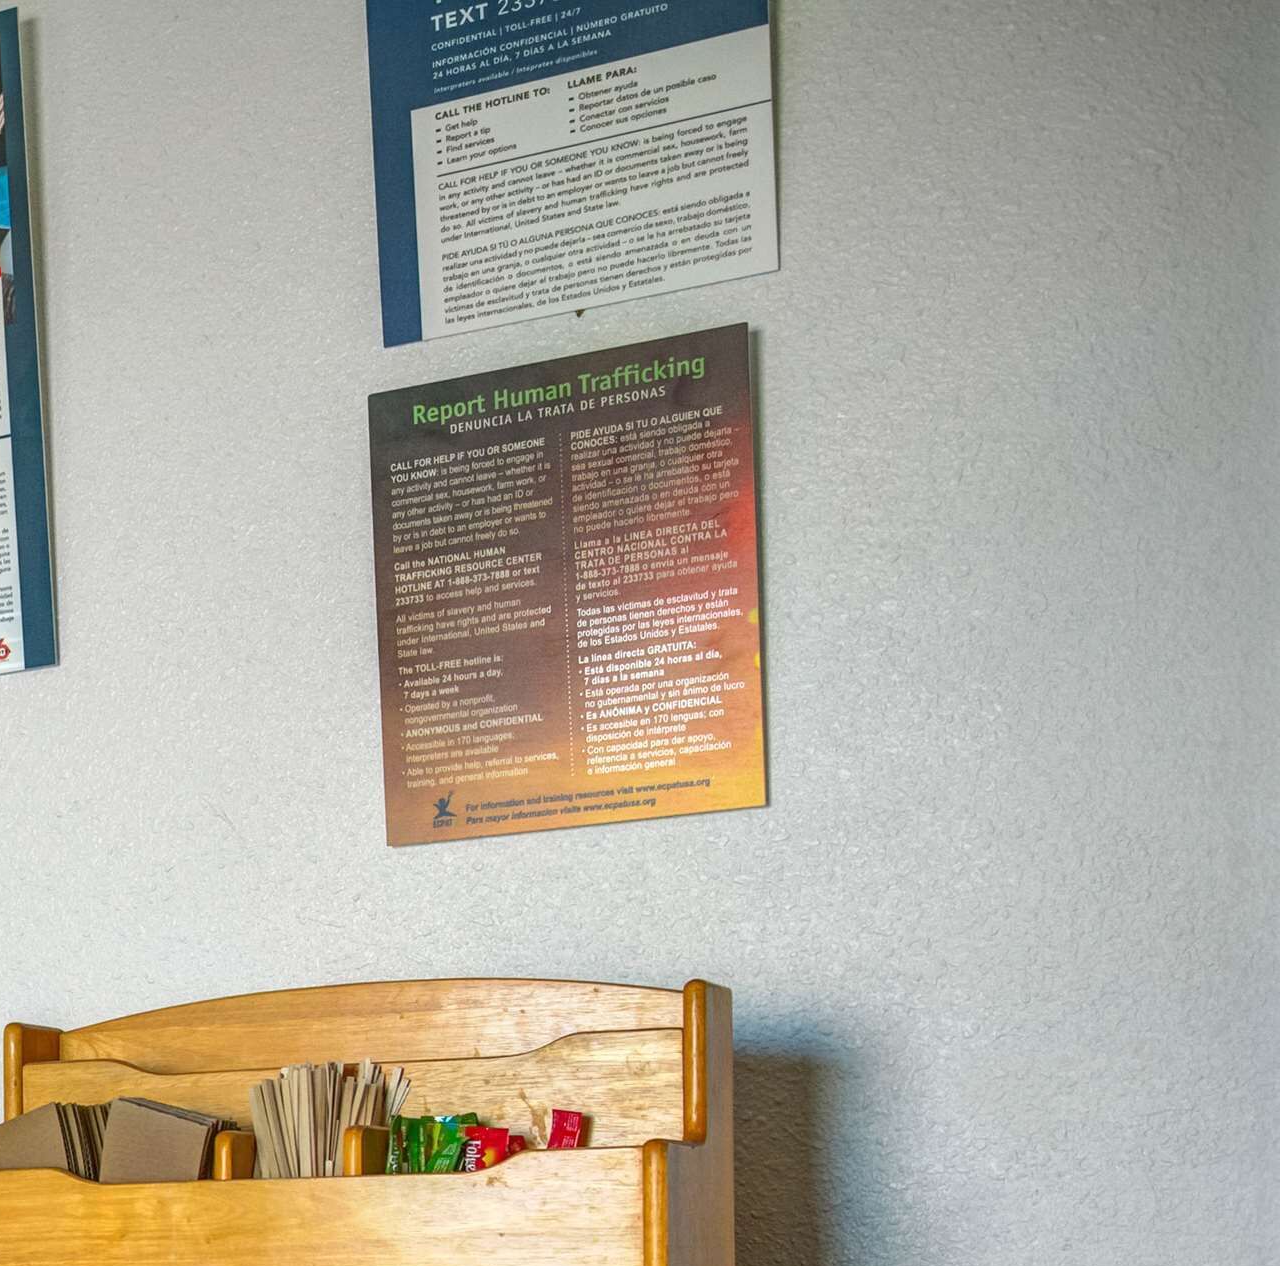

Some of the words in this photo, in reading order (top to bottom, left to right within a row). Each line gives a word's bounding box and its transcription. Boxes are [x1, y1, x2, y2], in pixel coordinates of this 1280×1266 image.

[430, 2, 488, 31] TEXT
[431, 29, 496, 51] CONFIDENTIAL
[505, 14, 552, 32] TOLL-FREE
[561, 7, 580, 19] 24/7
[499, 29, 568, 51] CONFIDENCIAL
[620, 3, 668, 21] GRATUITO
[433, 71, 443, 79] 24
[446, 62, 476, 76] HORAS
[479, 59, 490, 68] AL
[493, 55, 512, 64] DÍA,
[515, 51, 520, 59] 7
[523, 45, 544, 57] DÍAS
[547, 43, 554, 51] A
[557, 40, 568, 48] LA
[571, 29, 611, 45] SEMANA
[567, 74, 602, 89] LLAME
[605, 66, 637, 80] PARA:
[578, 88, 612, 100] Obtener
[614, 80, 638, 92] ayuda
[578, 98, 614, 111] Reportar
[615, 92, 638, 103] datos
[640, 88, 651, 97] de
[665, 78, 695, 92] posible
[697, 74, 717, 83] caso
[435, 108, 460, 120] CALL
[462, 102, 482, 113] THE
[485, 91, 529, 108] HOTLINE
[533, 87, 550, 97] TO:
[445, 123, 459, 131] Get
[461, 119, 478, 128] help
[445, 131, 471, 142] Report
[480, 127, 491, 135] tip
[413, 395, 486, 425] Report
[494, 382, 571, 410] Human
[577, 357, 704, 394] Trafficking
[450, 414, 512, 434] DENUNCIA
[518, 410, 532, 422] LA
[537, 403, 574, 418] TRATA
[580, 398, 595, 411] DE
[600, 386, 665, 407] PERSONAS
[570, 429, 591, 440] PIDE
[592, 424, 623, 436] AYUDA
[625, 421, 634, 431] SI
[635, 419, 648, 428] TU
[650, 417, 658, 426] O
[659, 410, 700, 424] ALGUIEN
[702, 405, 722, 416] QUE
[390, 461, 412, 472] CALL
[414, 457, 432, 468] FOR
[433, 453, 455, 464] HELP
[457, 451, 464, 460] IF
[466, 448, 485, 458] YOU
[487, 445, 500, 455] OR
[501, 437, 545, 452] SOMEONE
[570, 435, 617, 450] CONOCES:
[391, 473, 408, 483] YOU
[578, 656, 589, 664] La
[614, 648, 644, 659] directa
[647, 641, 696, 654] GRATUITA:
[405, 724, 460, 737] ANONYMOUS
[462, 721, 478, 730] and
[479, 713, 543, 728] CONFIDENTIAL
